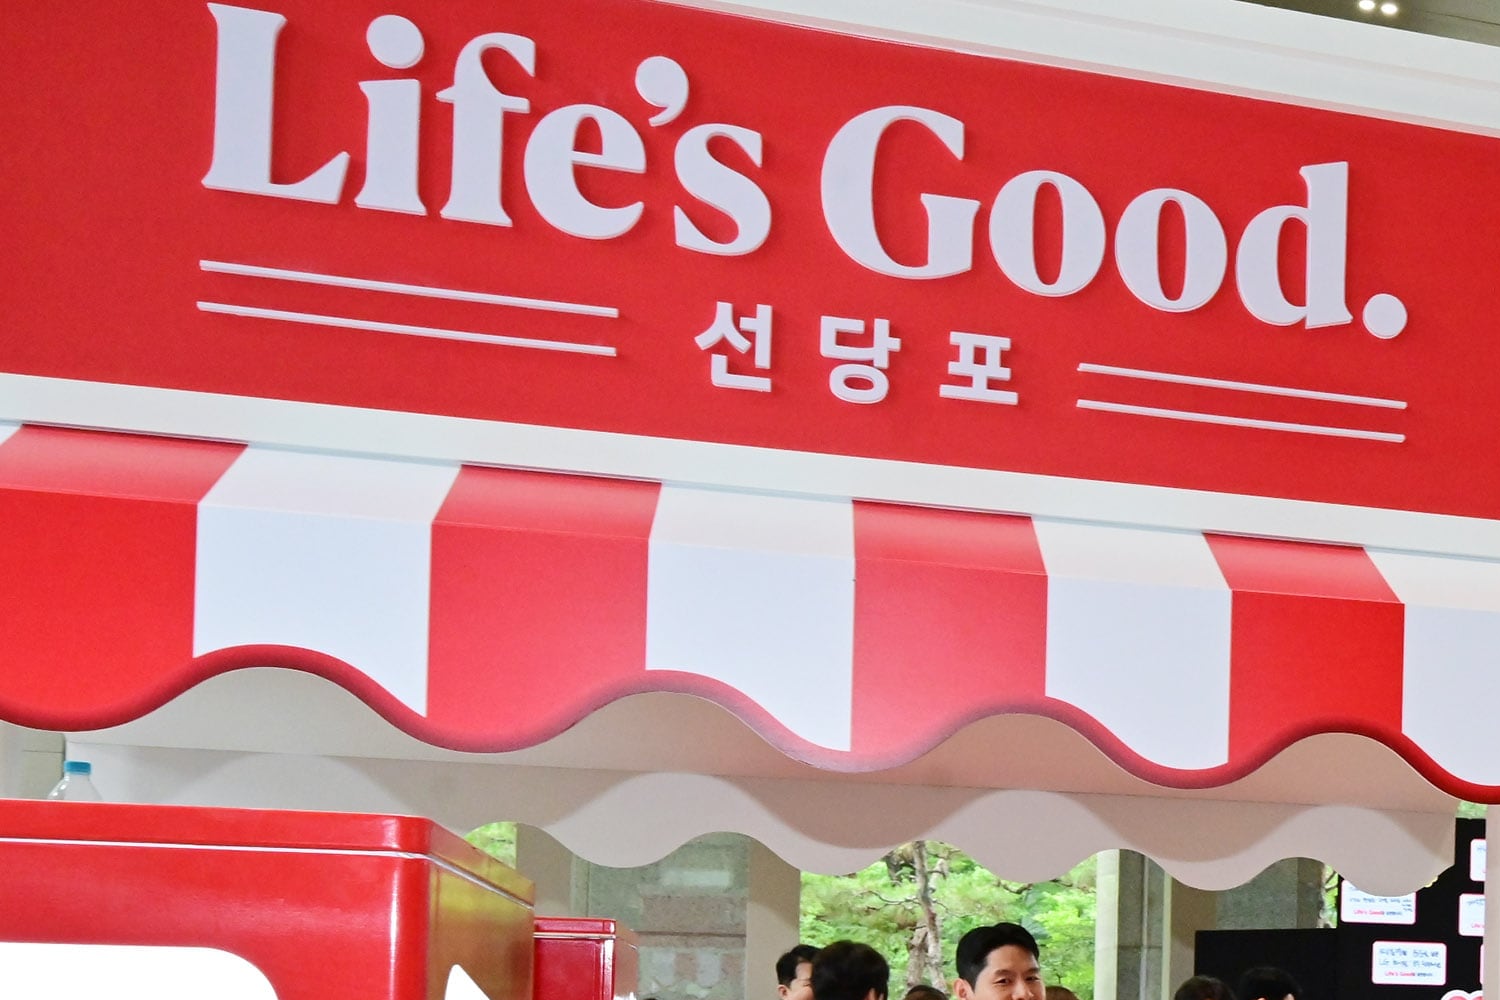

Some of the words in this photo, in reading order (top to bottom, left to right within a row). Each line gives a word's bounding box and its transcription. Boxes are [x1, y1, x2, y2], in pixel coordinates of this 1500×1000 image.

[203, 2, 771, 258] Life's
[820, 103, 1408, 338] Good.
[693, 300, 1019, 406] 선당포
